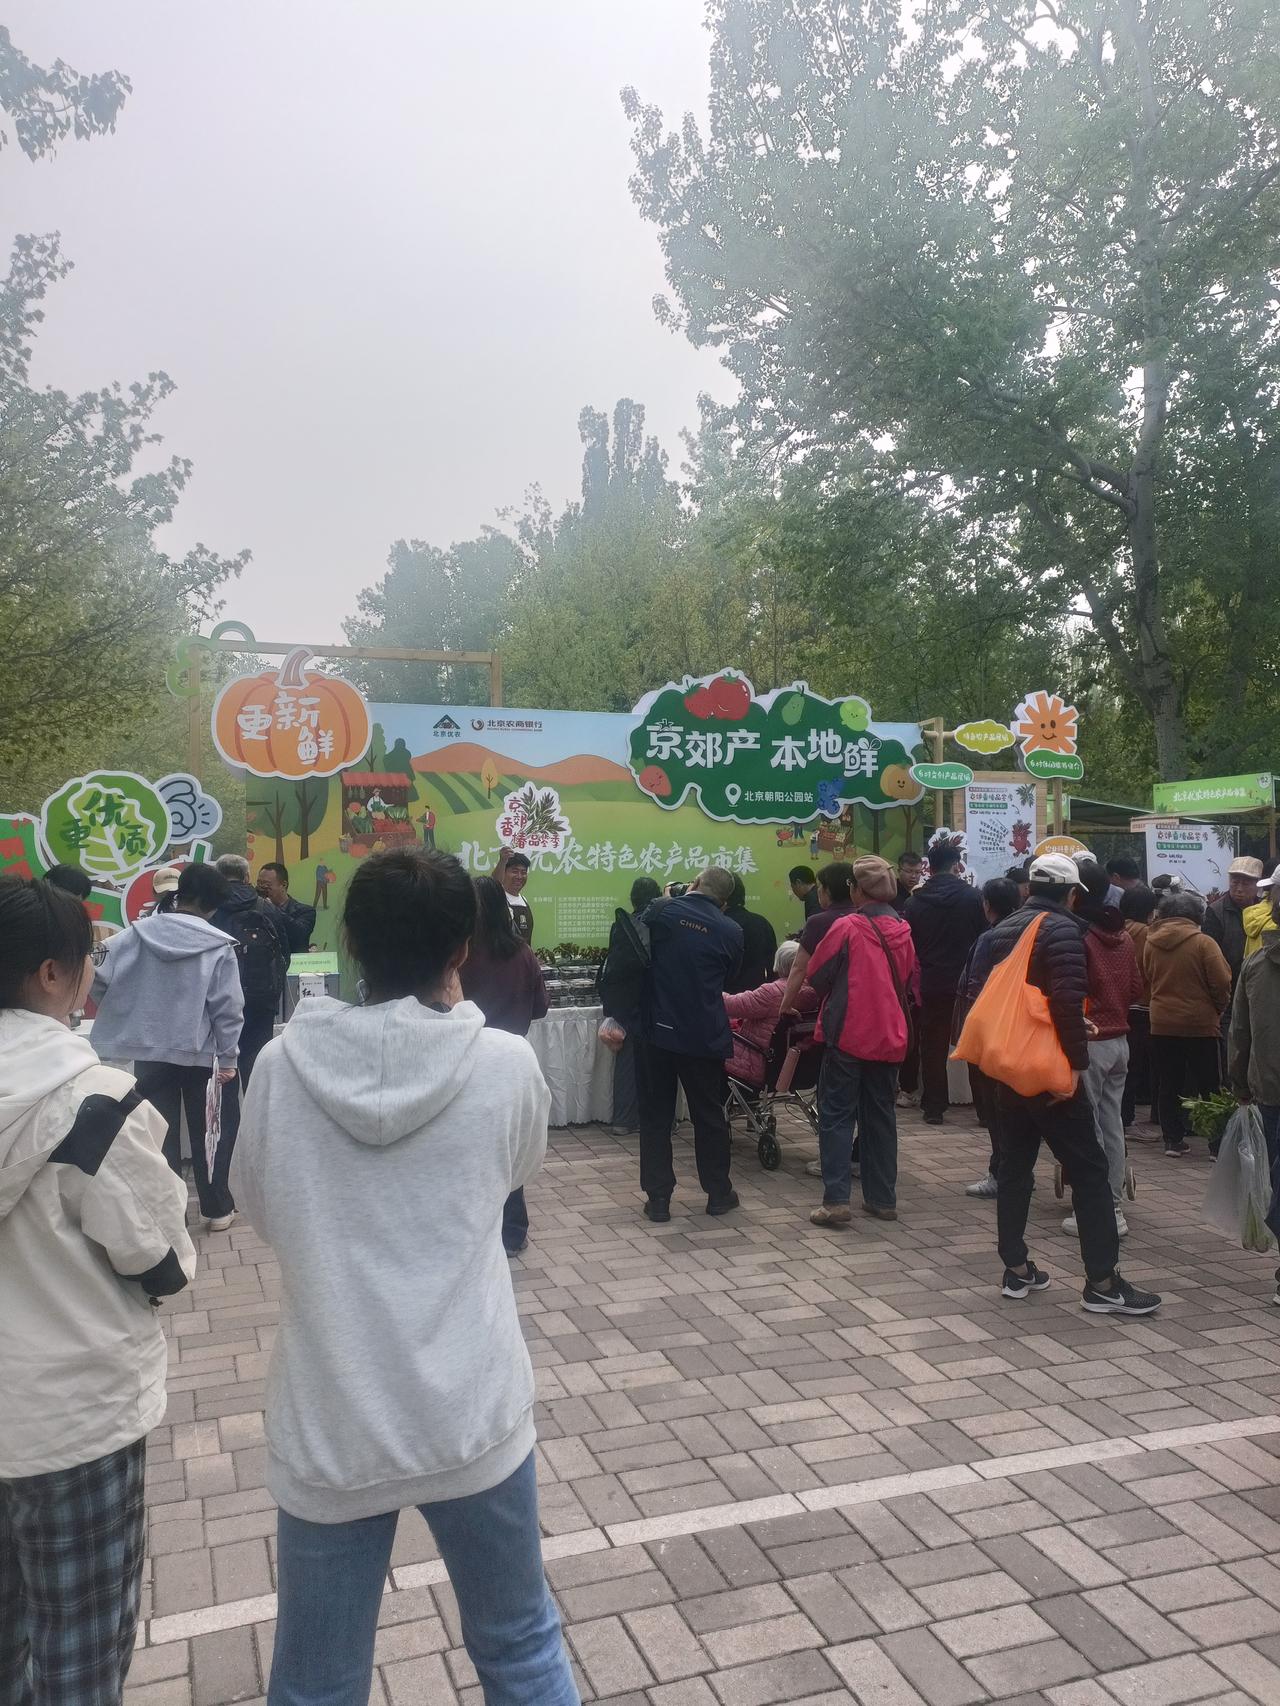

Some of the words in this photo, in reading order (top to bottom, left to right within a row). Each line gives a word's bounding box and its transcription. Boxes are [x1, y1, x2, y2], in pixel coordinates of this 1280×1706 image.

[237, 690, 334, 765] 更新鲜
[433, 730, 461, 738] 北京优农
[487, 719, 543, 728] 北京农商银行
[646, 720, 760, 768] 京郊产
[770, 729, 881, 777] 本地鲜
[744, 790, 814, 803] 北京朝阳公园站
[60, 790, 148, 857] 更优质
[456, 837, 759, 876] 北农特色农产品市集
[679, 919, 708, 934] CHINA
